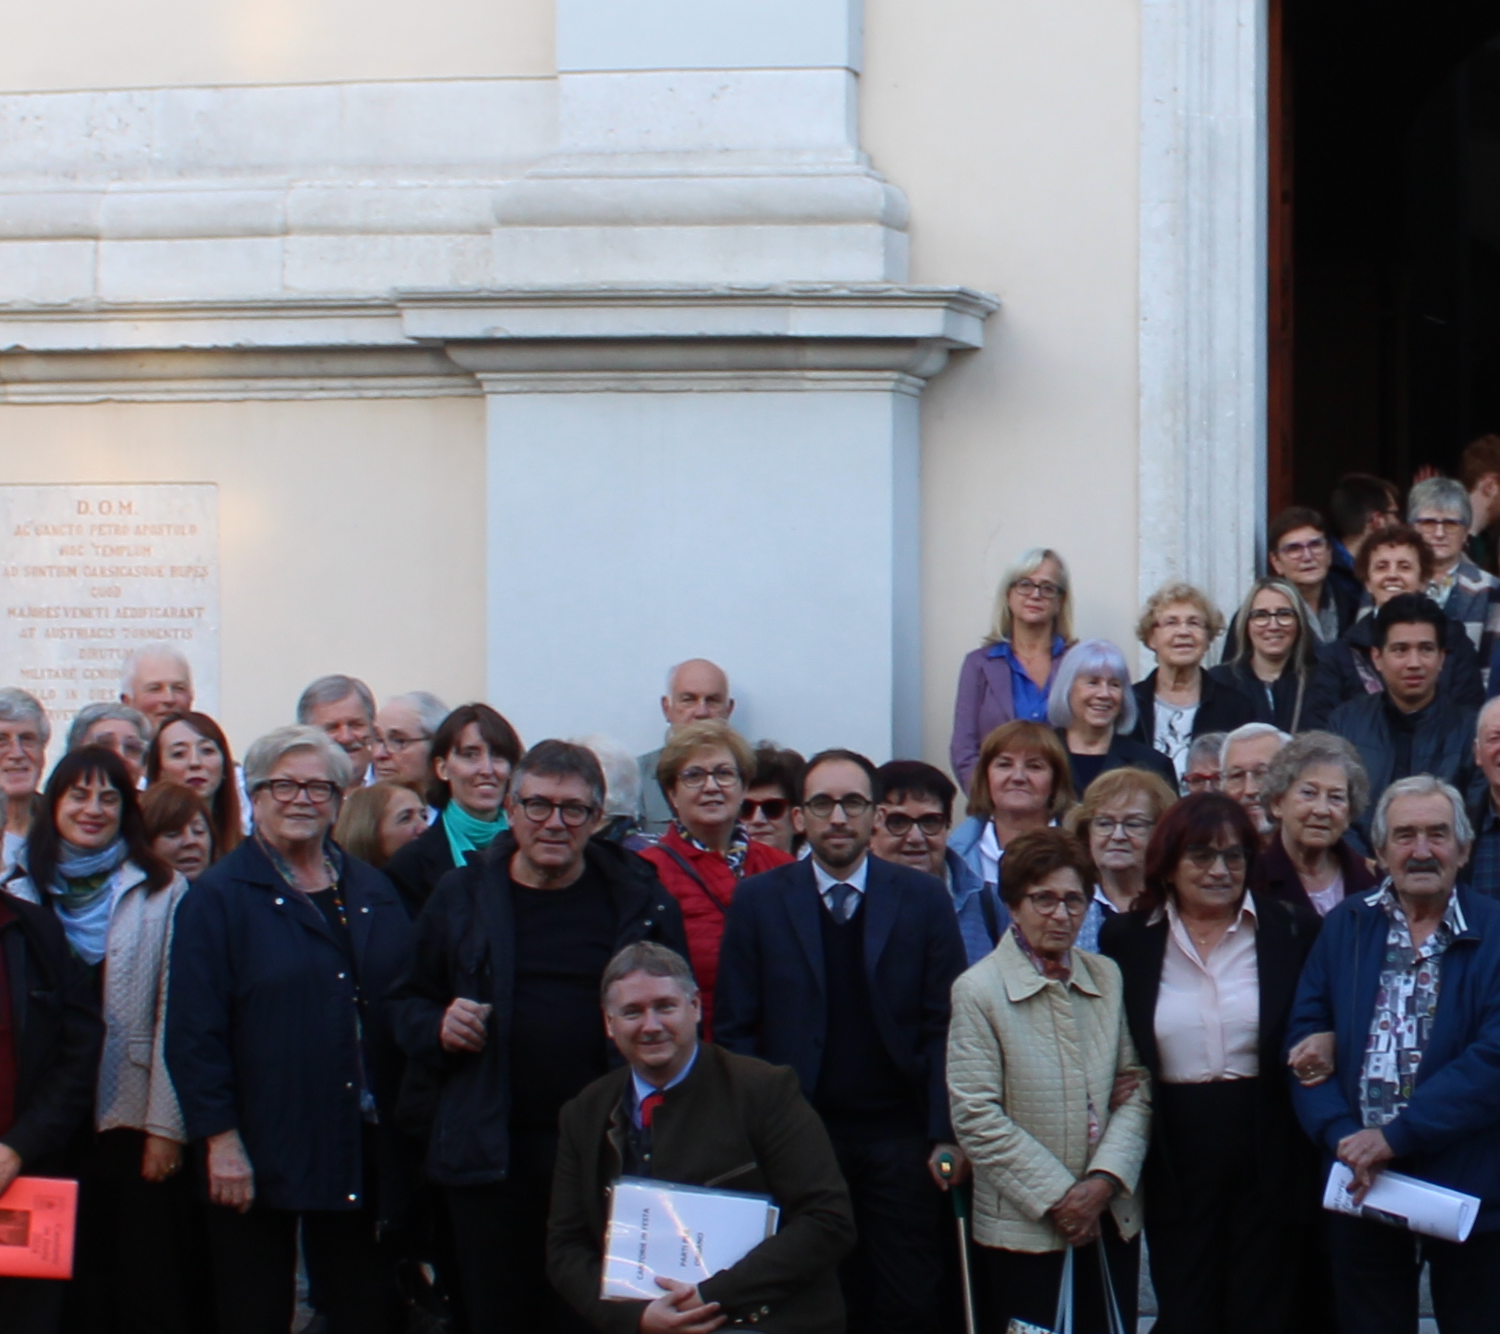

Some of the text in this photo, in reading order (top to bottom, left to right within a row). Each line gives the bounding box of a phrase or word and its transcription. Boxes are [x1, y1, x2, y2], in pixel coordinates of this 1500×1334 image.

[35, 523, 83, 537] SANCTO
[89, 523, 130, 537] PETRO
[133, 523, 198, 537] APOSTOLO
[59, 544, 152, 557] HOC TEMPLUM
[3, 566, 18, 577] AD
[170, 565, 209, 578] RUPES
[90, 585, 122, 599] QUOD
[63, 606, 110, 619] VENETI
[115, 606, 206, 619] AEDIFICARANT
[44, 627, 116, 639] AUSTRIACIS
[122, 627, 194, 639] TORMENTIS
